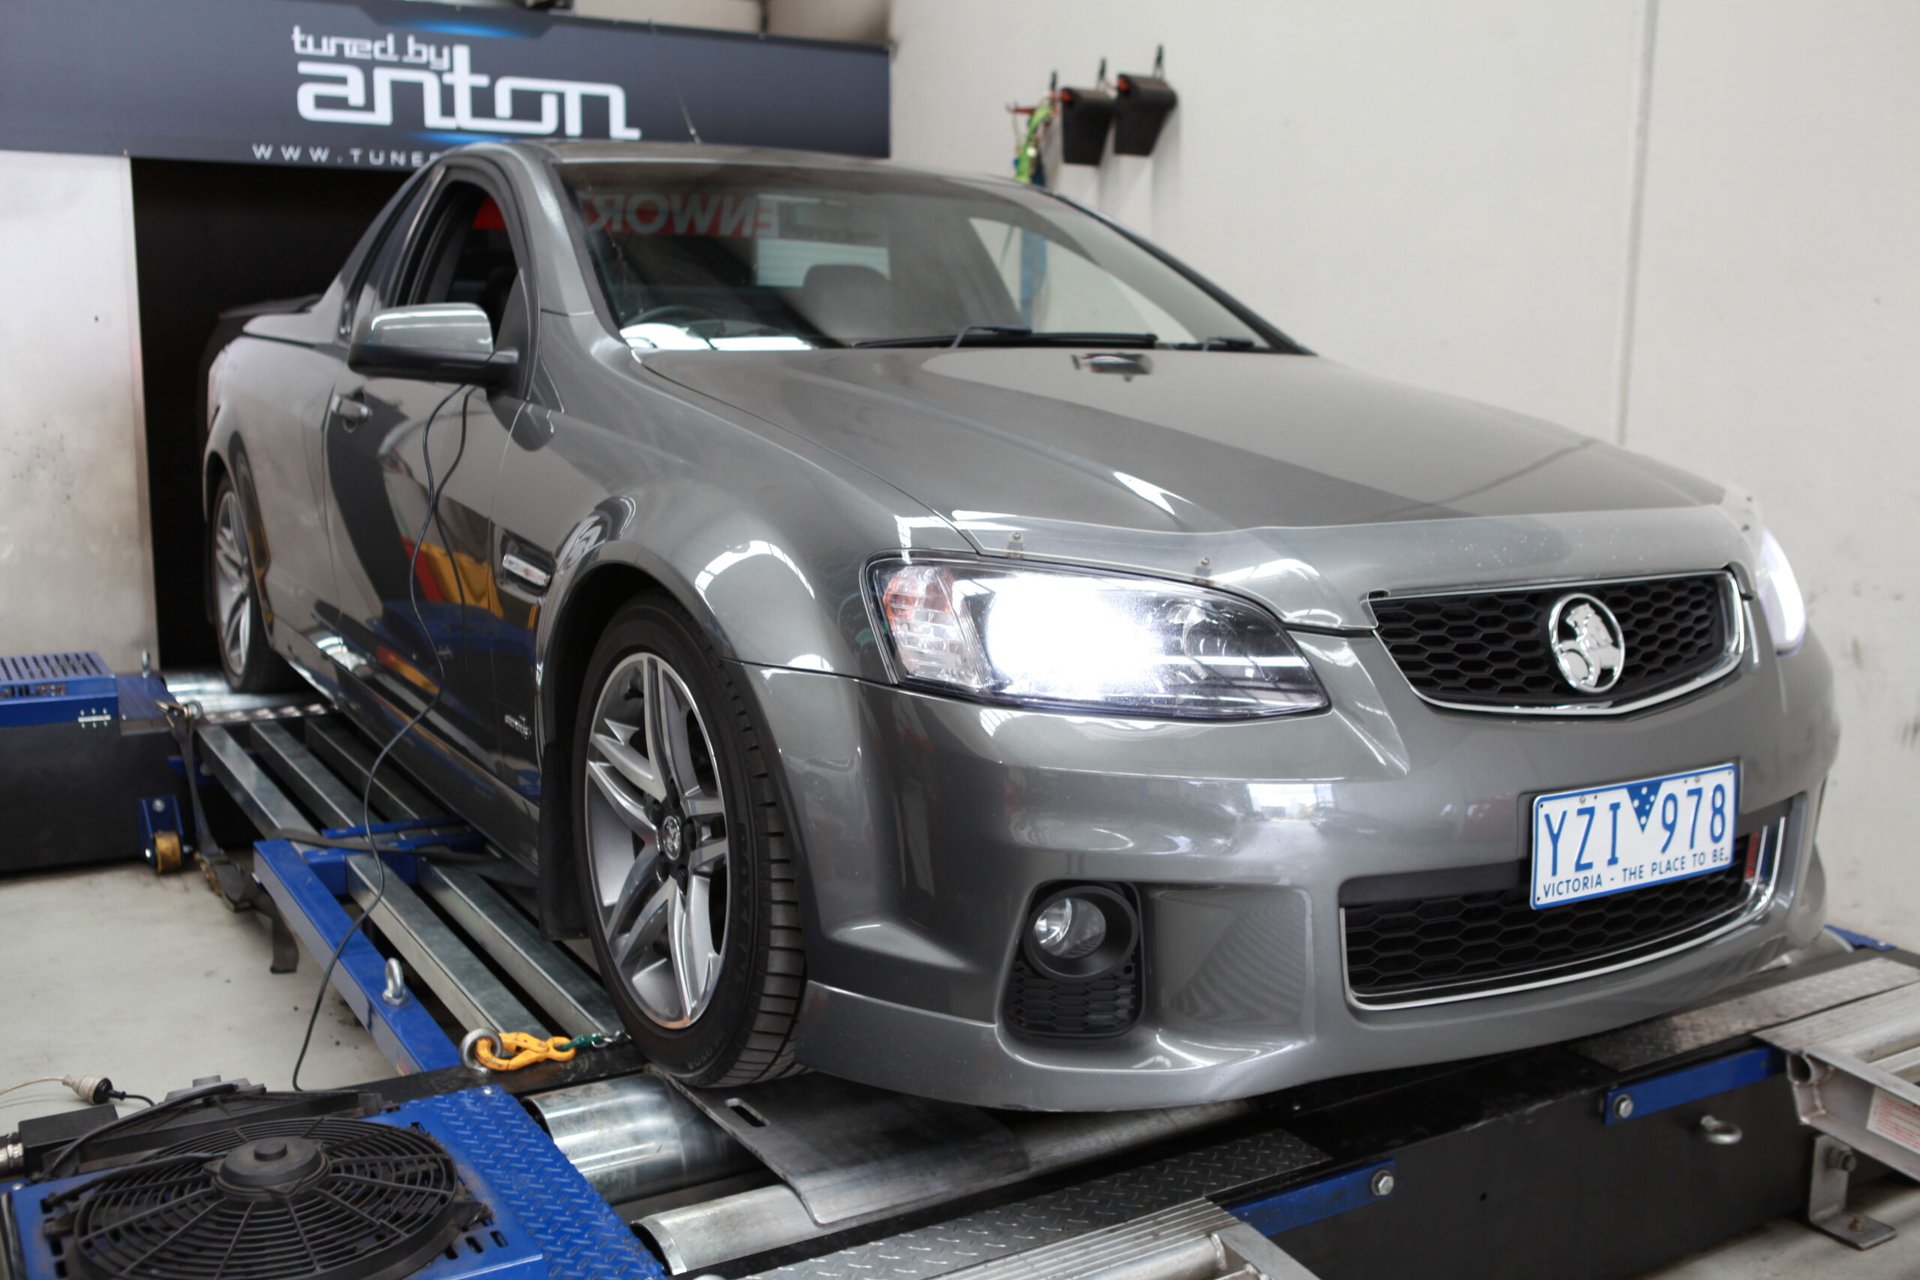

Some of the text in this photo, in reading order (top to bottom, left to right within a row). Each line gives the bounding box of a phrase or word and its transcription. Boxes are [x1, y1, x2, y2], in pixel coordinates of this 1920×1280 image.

[291, 25, 450, 71] tuned by
[297, 44, 642, 141] anton
[1544, 783, 1726, 876] YZI 978
[1543, 874, 1603, 899] VICTORIA
[1622, 865, 1645, 882] THE
[1650, 856, 1686, 877] PLACE
[1692, 852, 1706, 867] TO
